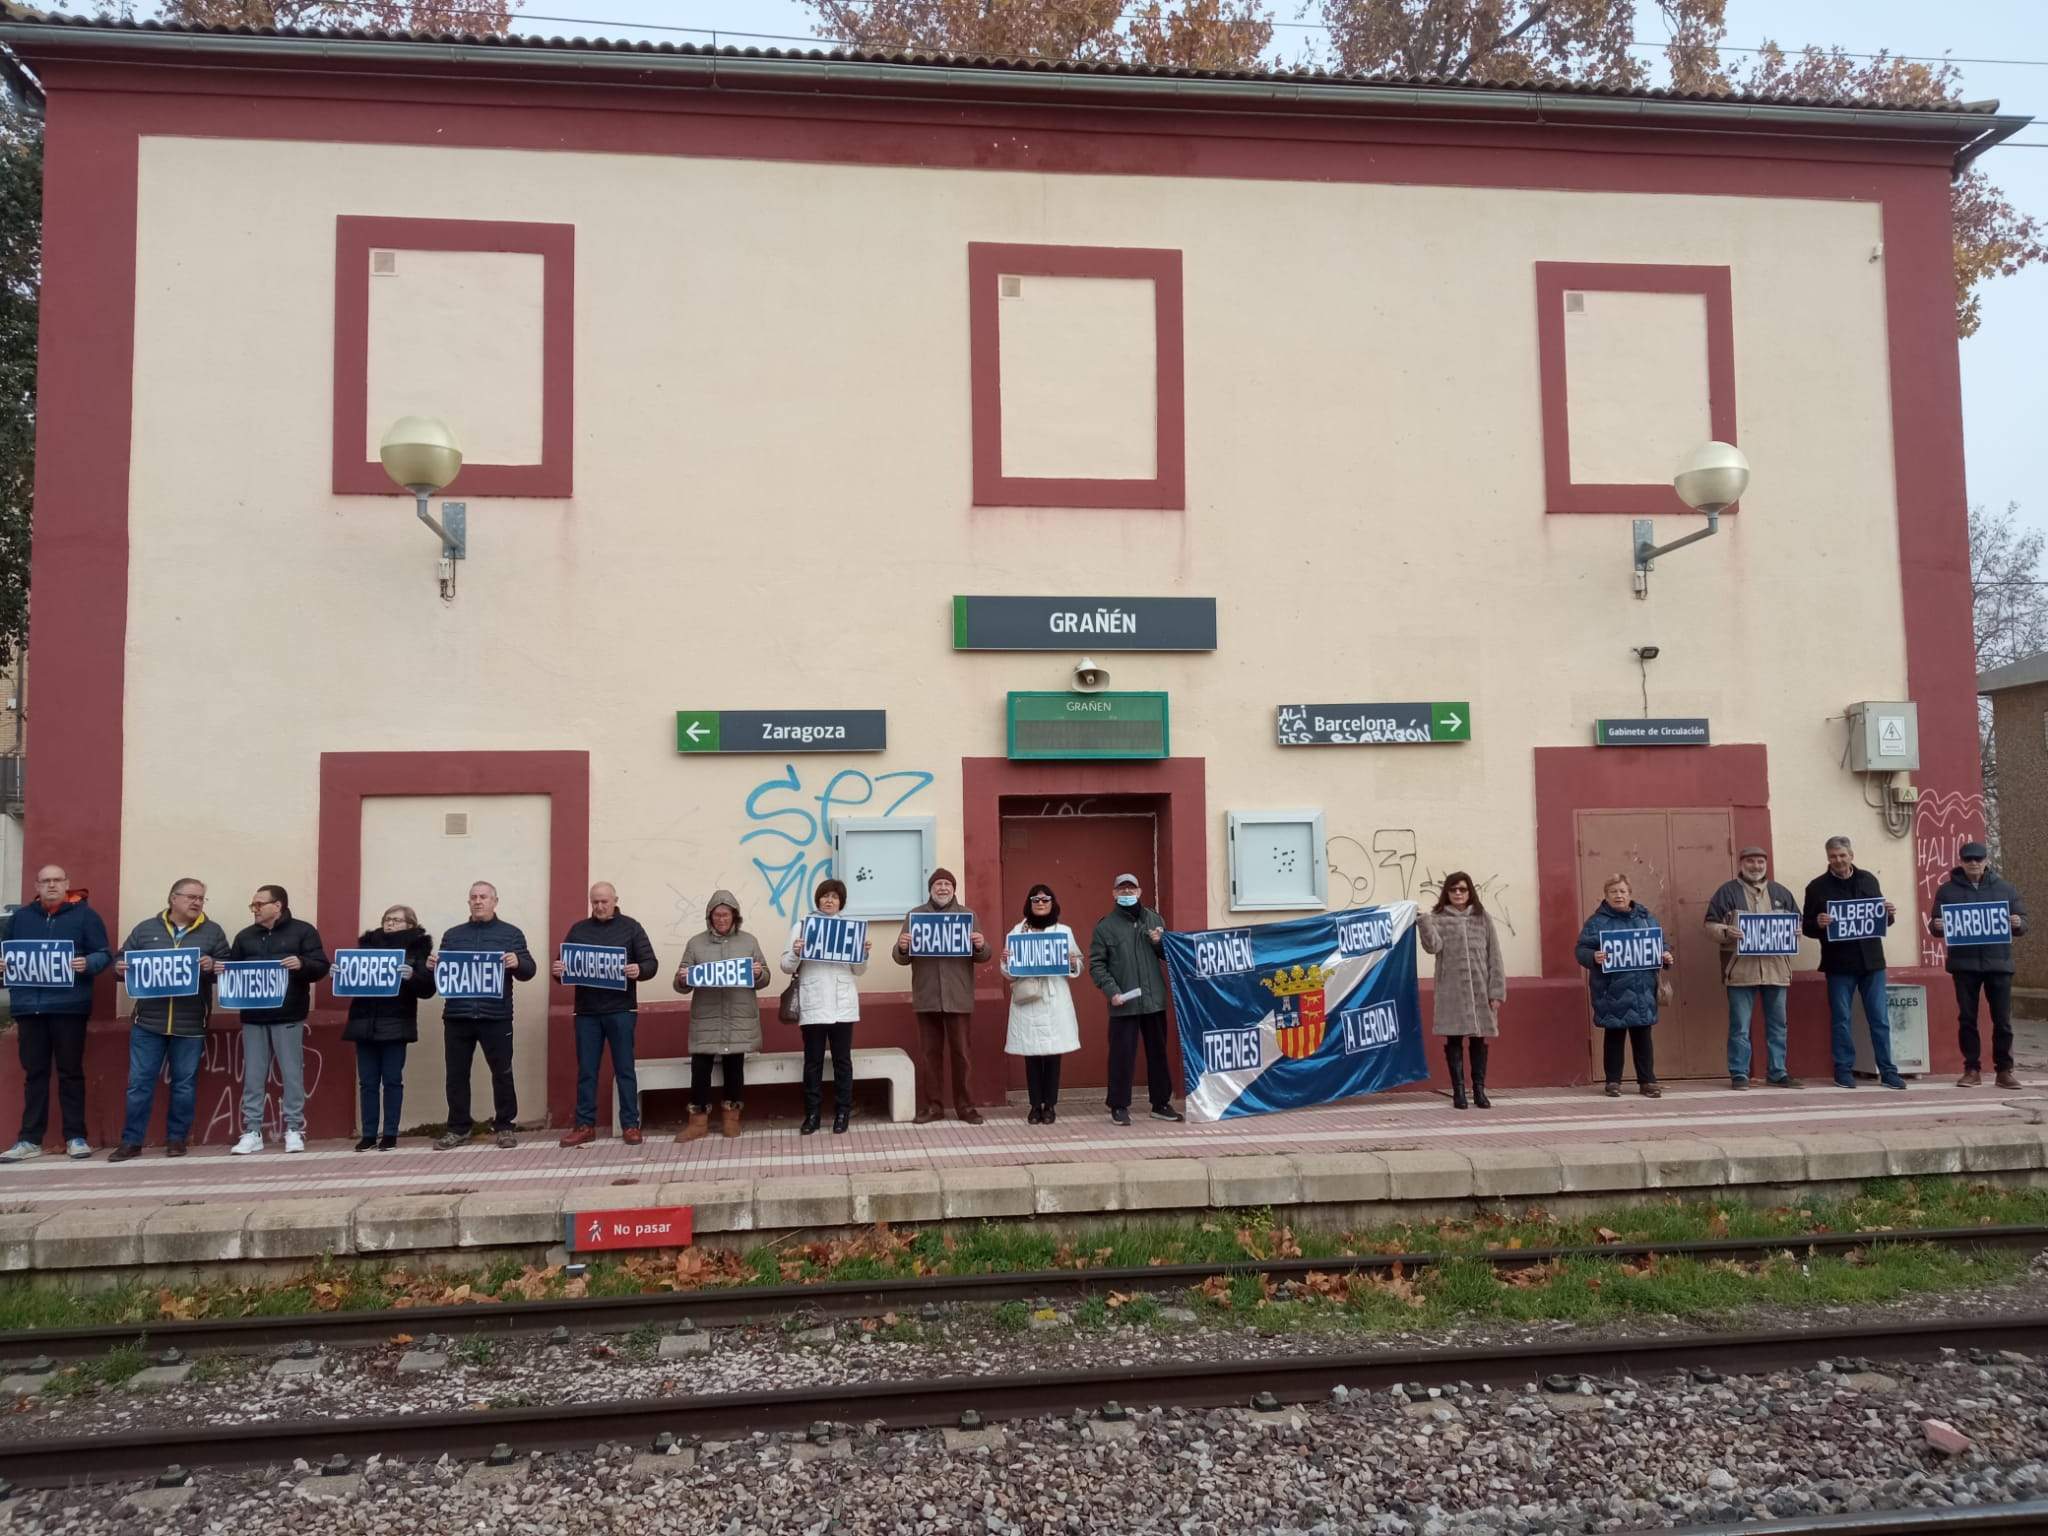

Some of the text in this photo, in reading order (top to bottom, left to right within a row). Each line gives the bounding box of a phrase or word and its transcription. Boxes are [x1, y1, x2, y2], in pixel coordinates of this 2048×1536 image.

[1049, 607, 1136, 633] GRAÑÉN
[762, 723, 846, 742] Zaragoza
[1314, 715, 1396, 731] Barcelona
[1608, 726, 1705, 736] Gabinete de Circulación
[1829, 902, 1885, 921] ALBERO
[1944, 908, 2009, 937] BARBUES
[804, 917, 865, 961] CALLEN
[911, 914, 971, 953] GRAÑÉN
[1340, 919, 1392, 953] QUEREMOS
[1739, 919, 1797, 952] SANGARREN
[1838, 919, 1875, 937] BAJO
[5, 942, 73, 983] GRAÑÉN
[562, 949, 625, 981] ALCUBIERRE
[1009, 939, 1068, 967] ALMUNIENTE
[1197, 931, 1251, 974] GRAÑÉN
[1602, 930, 1661, 968] GRAÑÉN
[131, 955, 192, 988] TORRES
[339, 956, 397, 987] ROBRES
[436, 954, 503, 993] GRAÑÉN
[692, 959, 748, 986] CURBE
[1347, 1016, 1356, 1050] A
[1205, 1032, 1260, 1069] TRENES
[614, 1222, 672, 1237] No pasar
